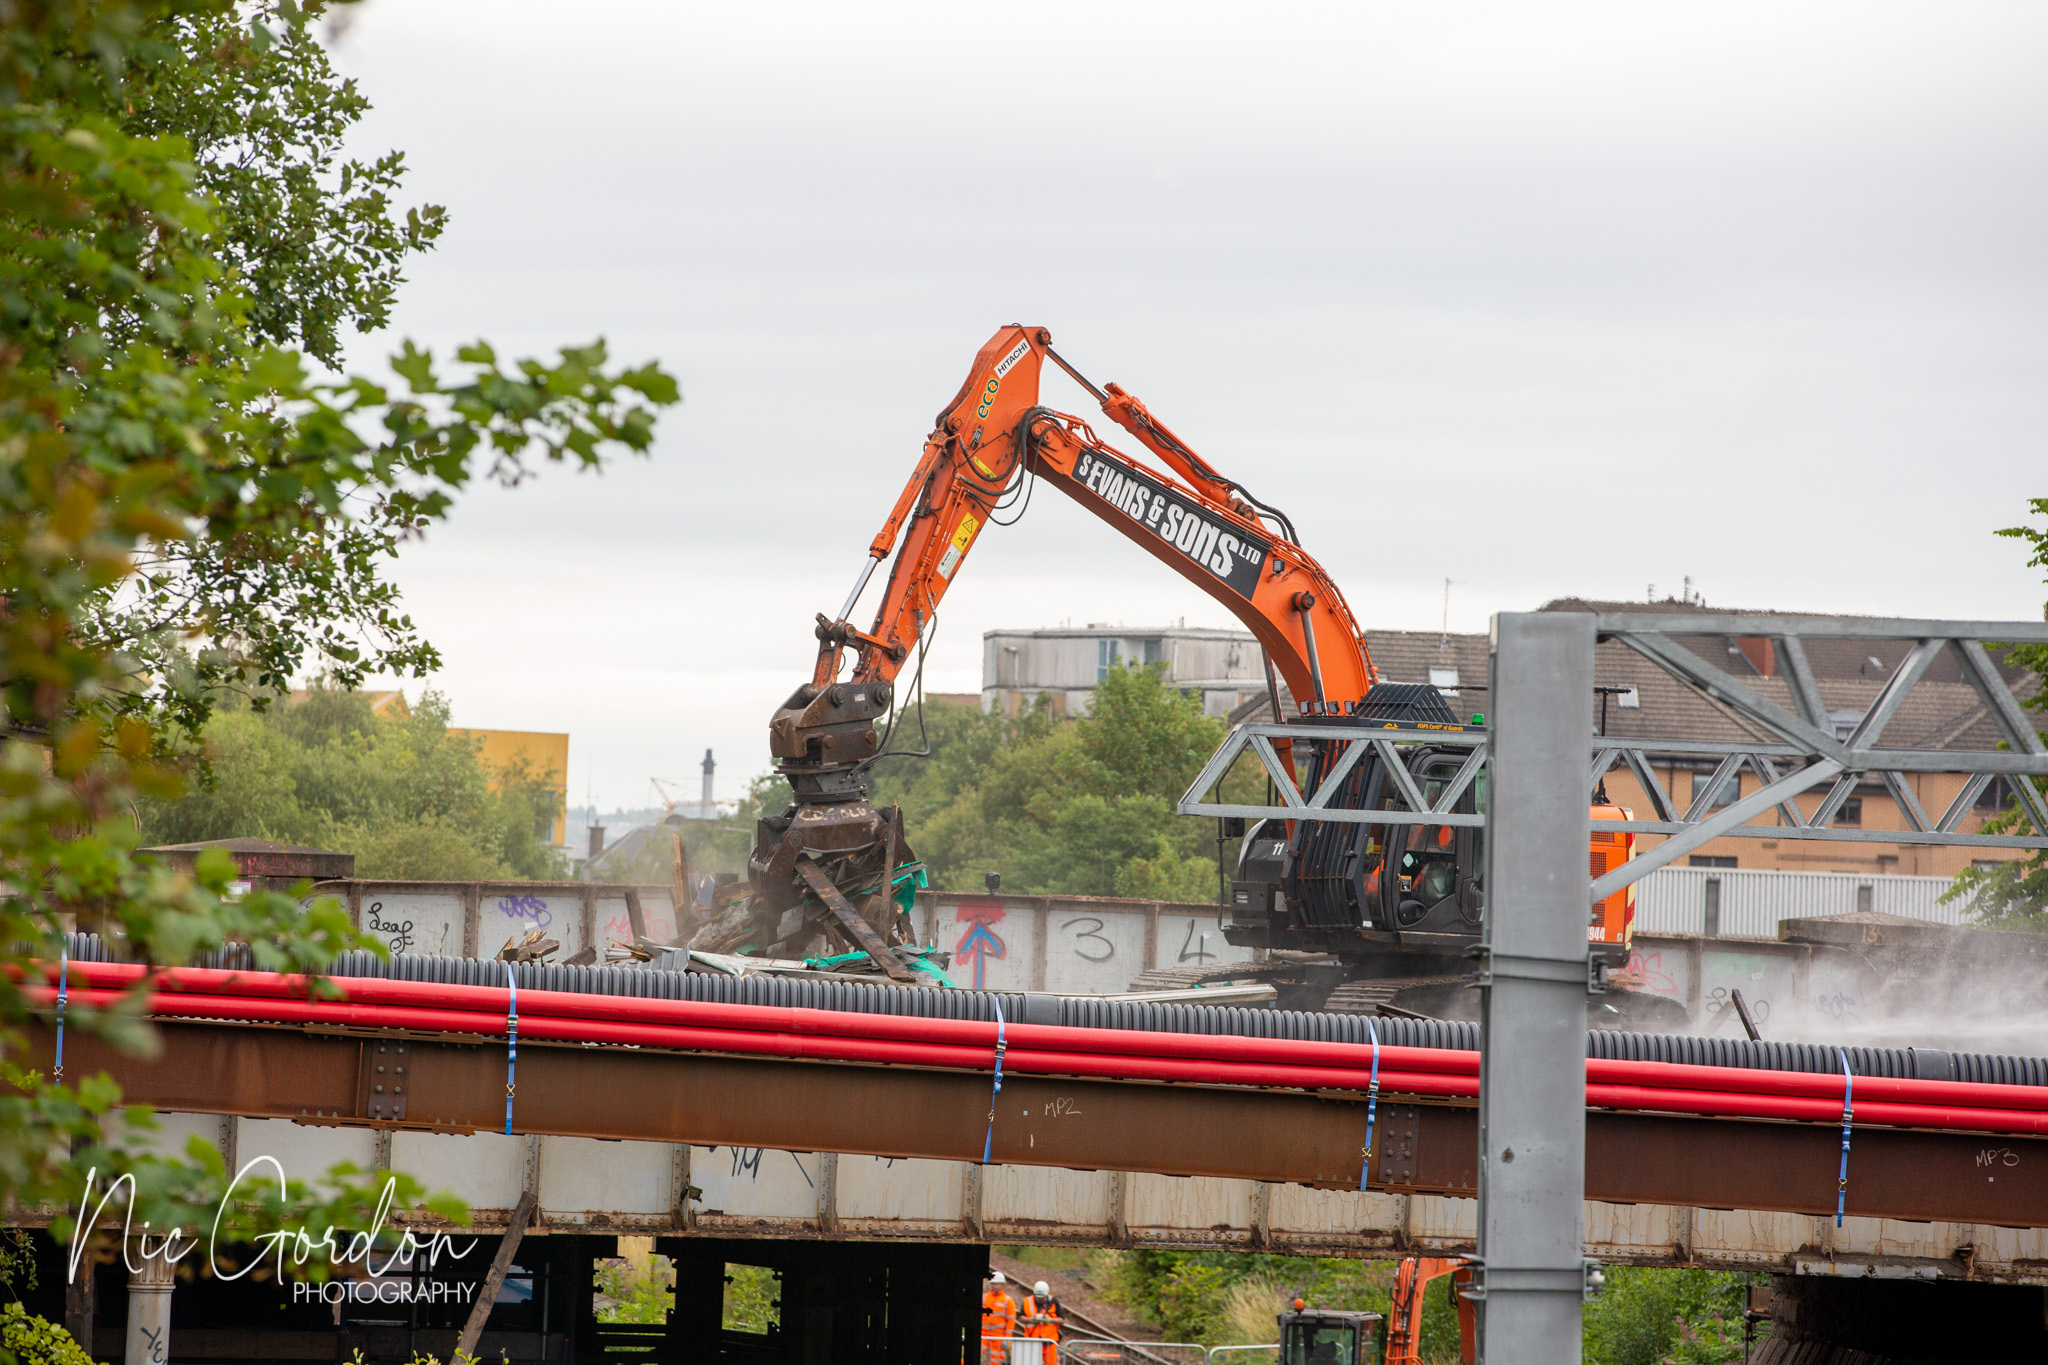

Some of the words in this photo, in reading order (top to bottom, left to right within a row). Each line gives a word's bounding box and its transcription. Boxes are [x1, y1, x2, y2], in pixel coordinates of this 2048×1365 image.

[997, 342, 1028, 374] HITACHI
[1078, 454, 1093, 477] S
[1086, 459, 1151, 521] EVANS
[1146, 494, 1166, 529] &
[1159, 503, 1240, 578] SONS
[1238, 542, 1262, 565] LTD
[1272, 842, 1285, 856] 11
[1061, 917, 1115, 963] 3
[1178, 919, 1217, 966] 4
[1587, 926, 1606, 942] 944
[1045, 1097, 1082, 1118] MP2
